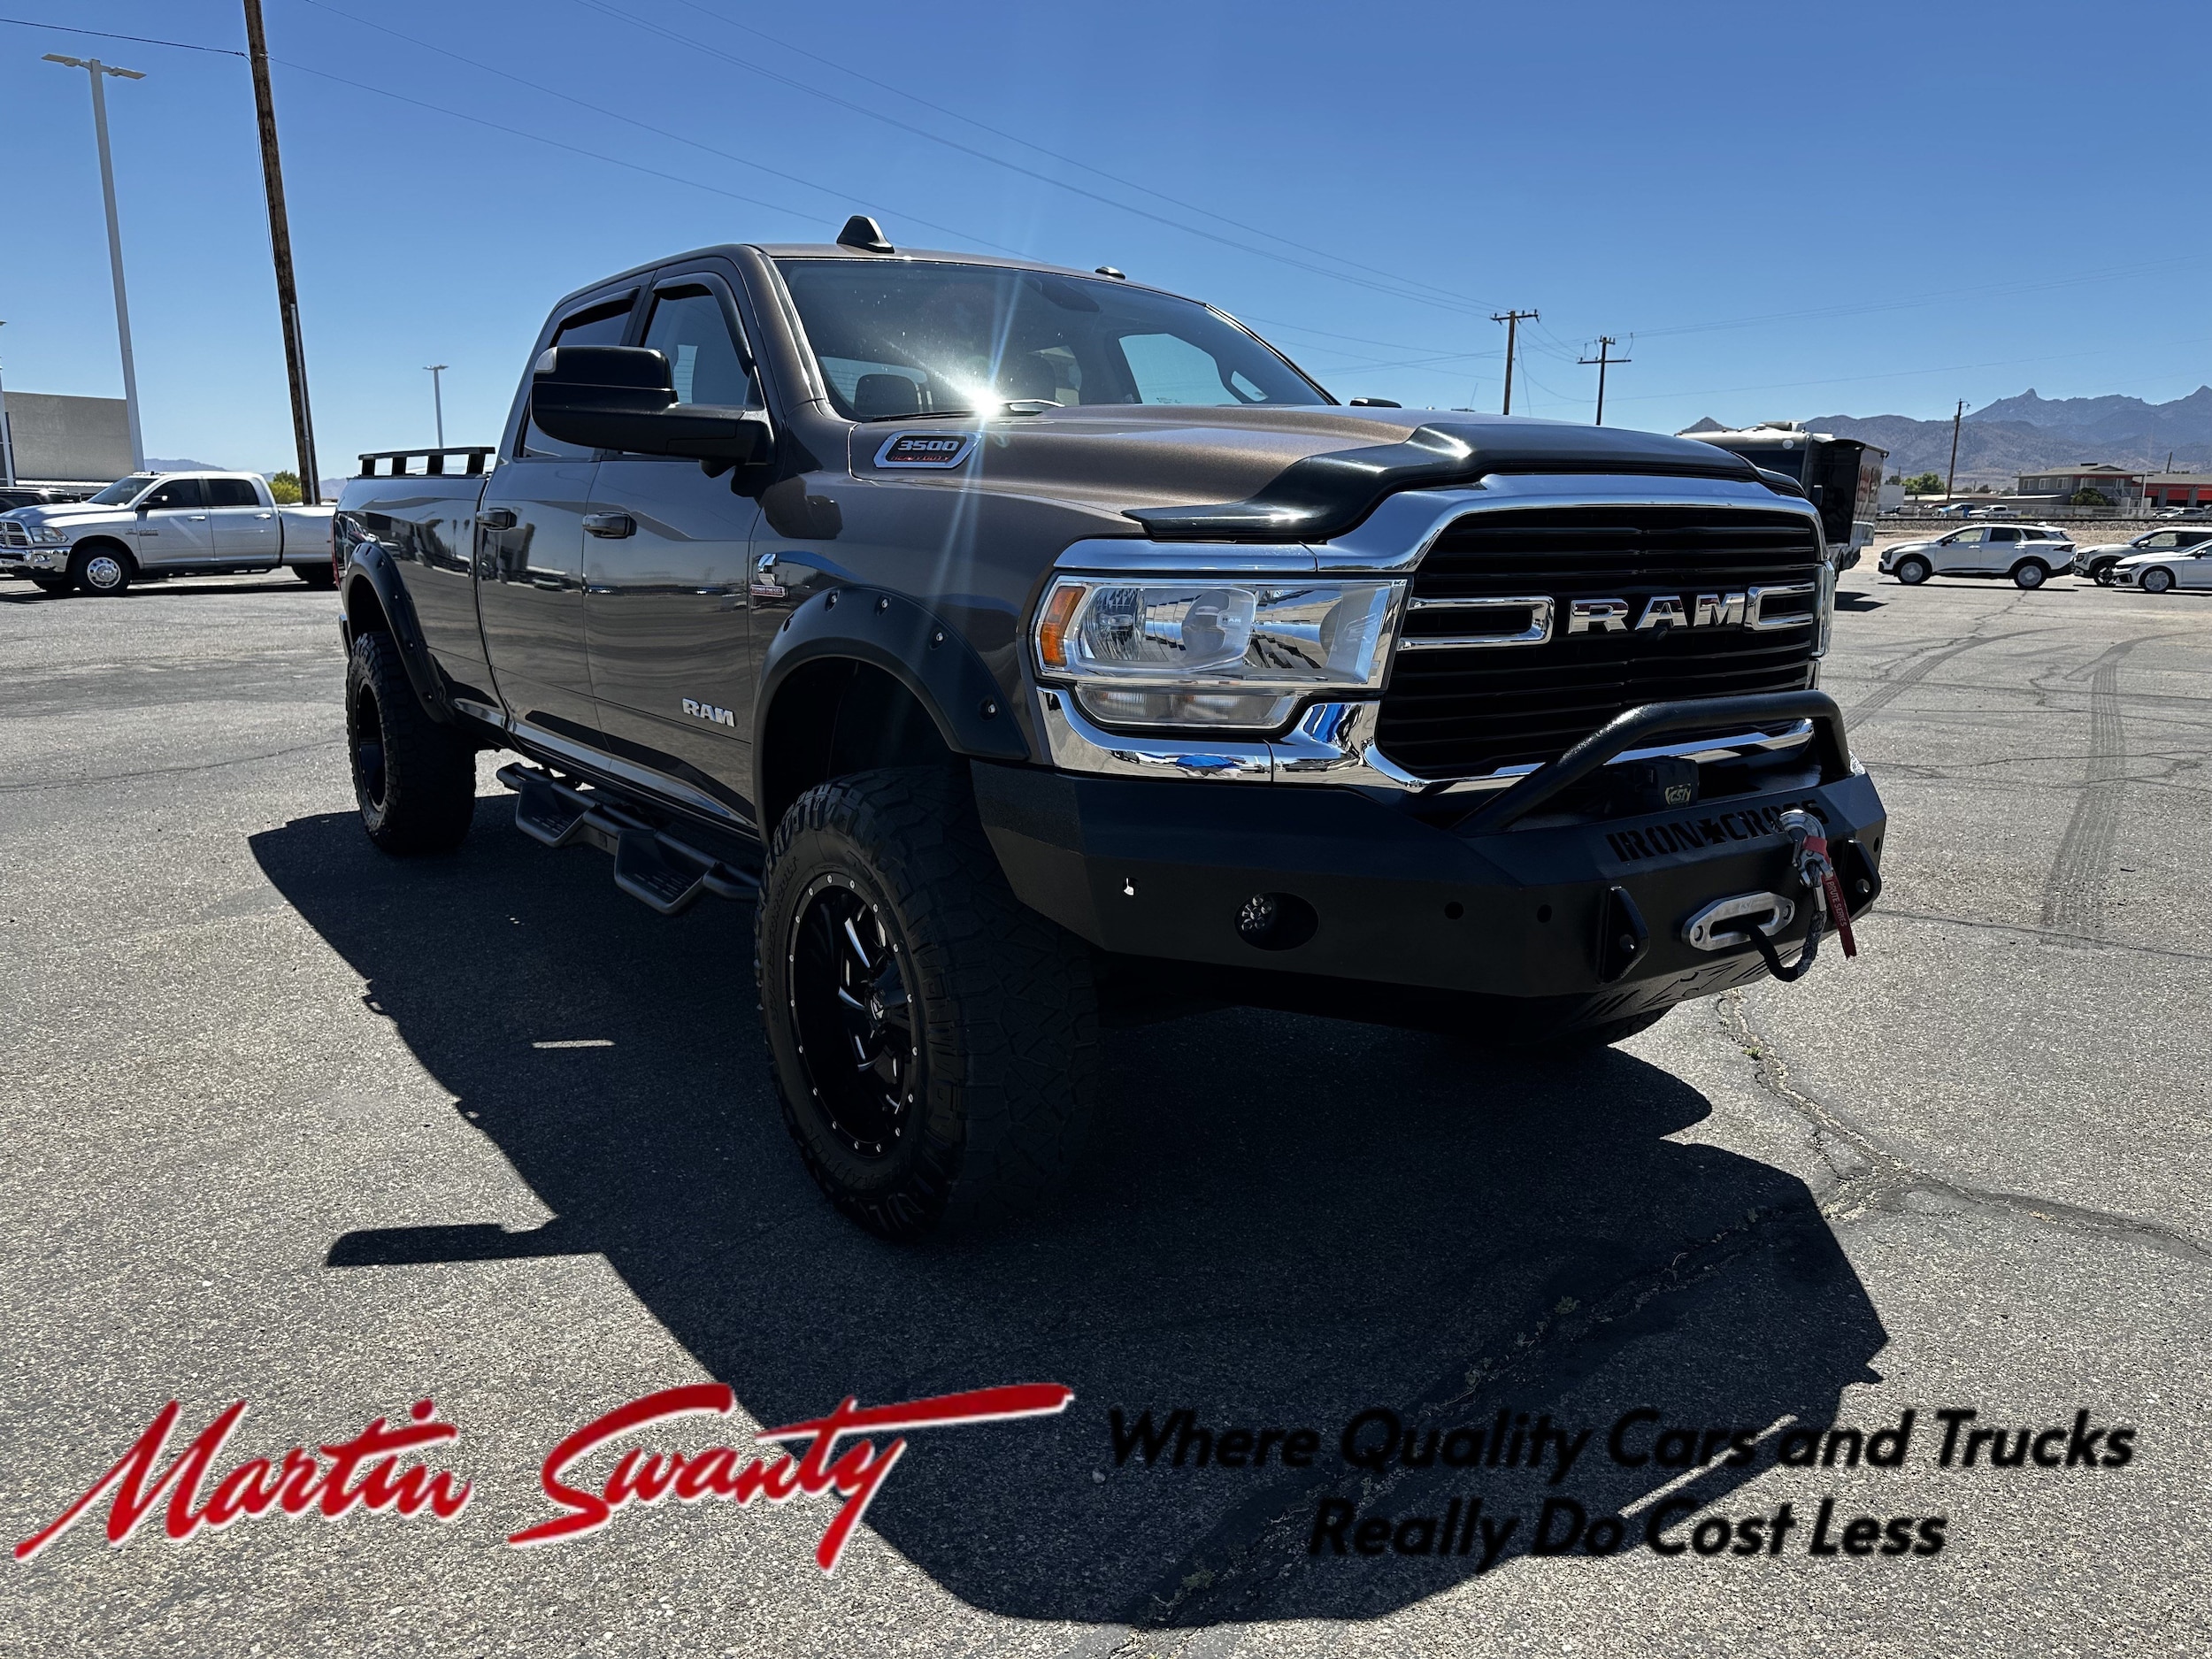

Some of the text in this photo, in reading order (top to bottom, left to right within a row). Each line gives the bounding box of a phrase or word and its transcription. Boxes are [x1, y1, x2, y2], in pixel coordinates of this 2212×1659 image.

[897, 440, 959, 451] 3500
[1568, 592, 1746, 635] RAM
[682, 698, 736, 727] RAM
[1606, 800, 1829, 862] IRON CROS
[1825, 881, 1840, 902] BRUTE
[1833, 902, 1847, 927] SERIES
